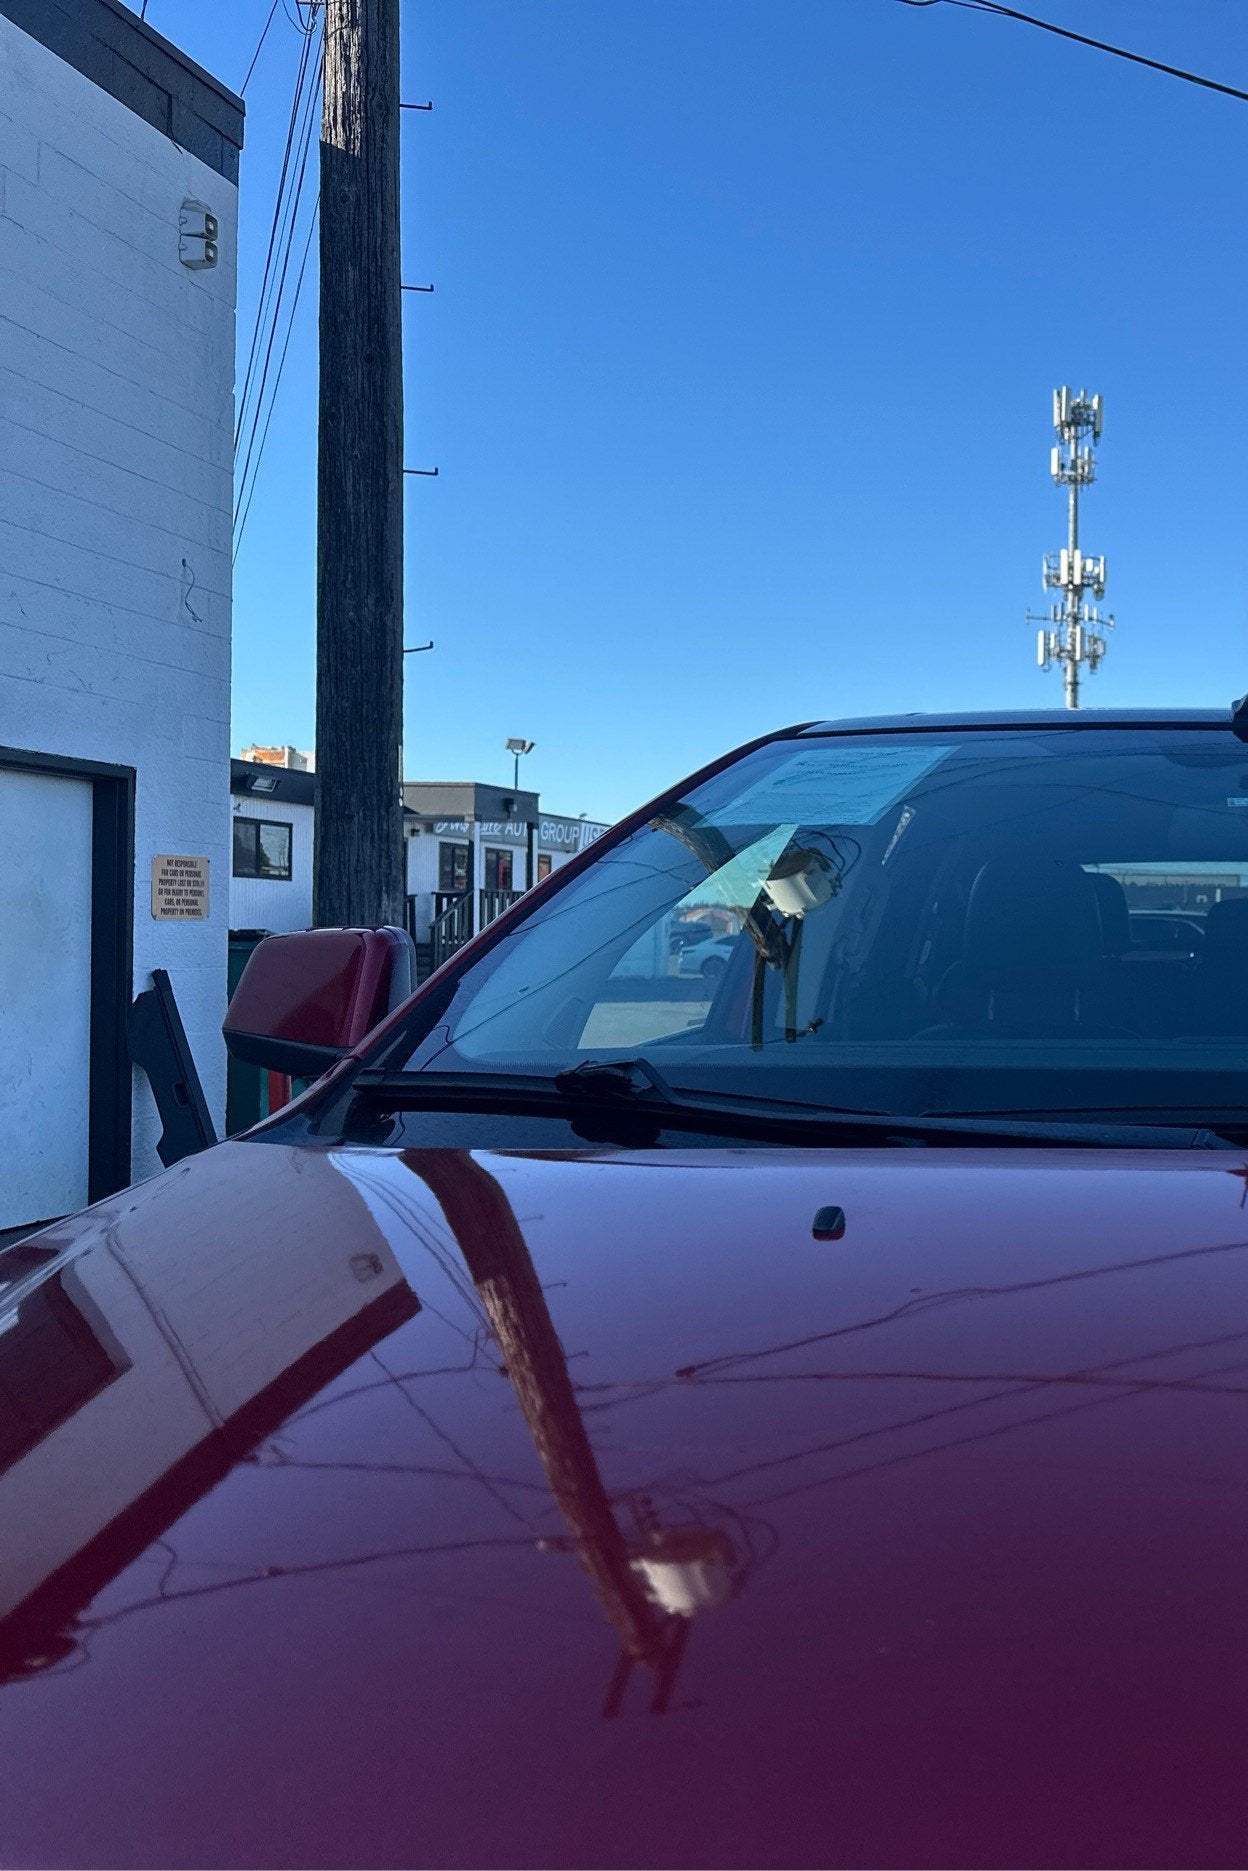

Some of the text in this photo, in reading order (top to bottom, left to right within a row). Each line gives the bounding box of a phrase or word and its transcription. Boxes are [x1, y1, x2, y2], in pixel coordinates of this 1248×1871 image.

[504, 822, 530, 837] AUT
[540, 821, 580, 844] GROUP
[175, 860, 197, 868] RESPONSIBLE
